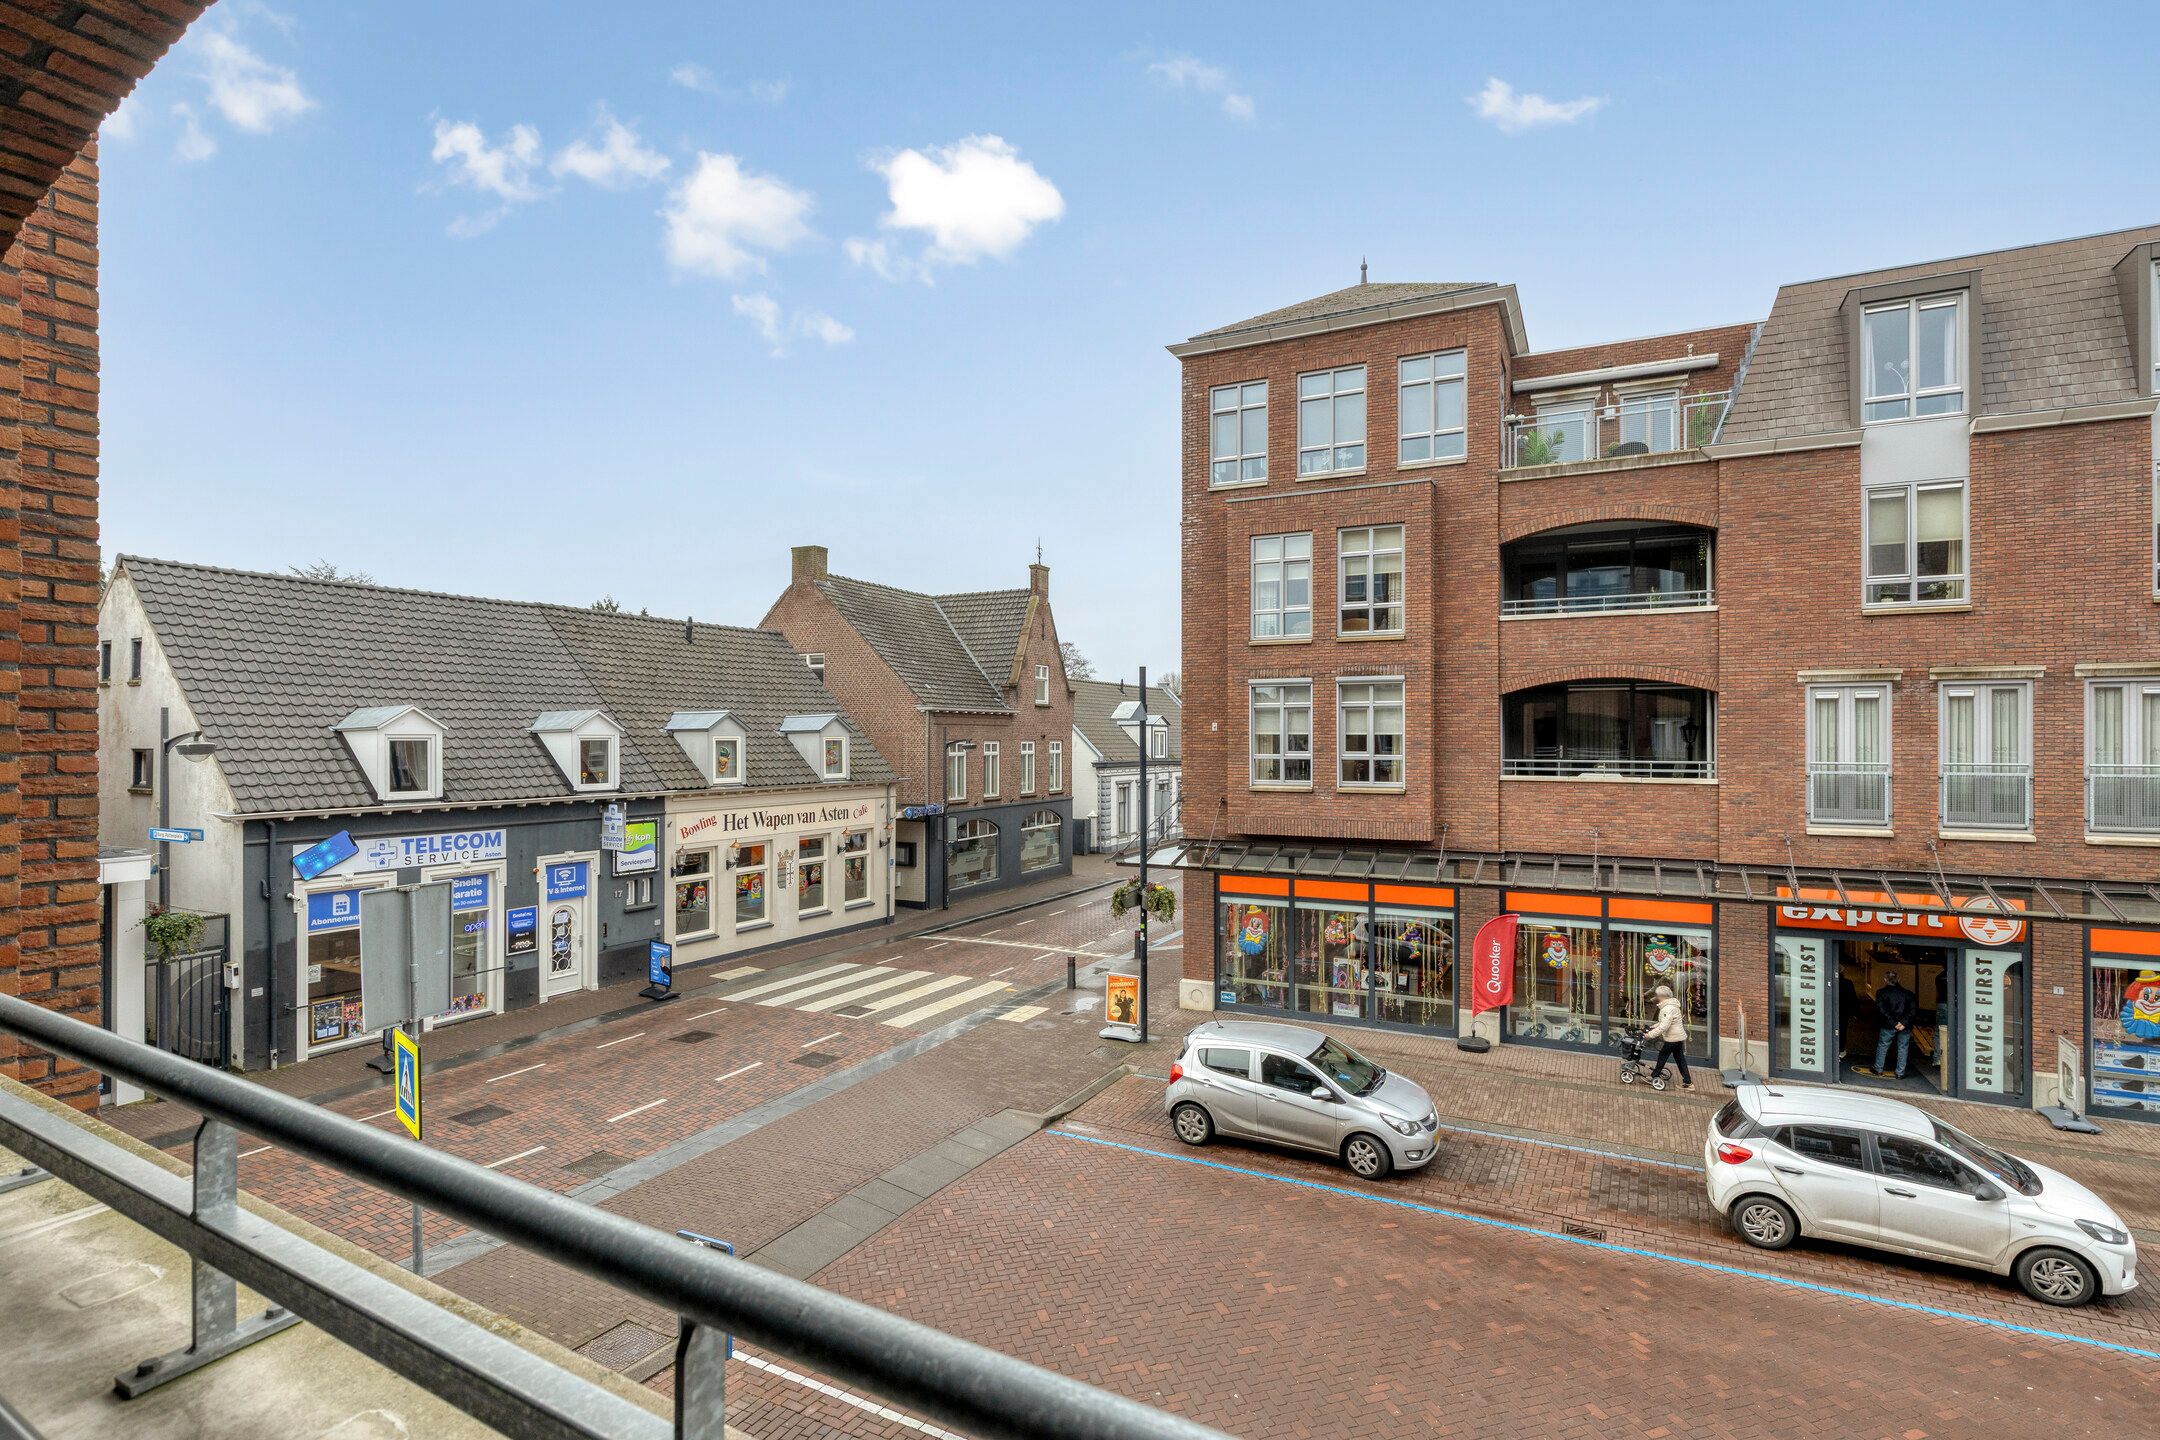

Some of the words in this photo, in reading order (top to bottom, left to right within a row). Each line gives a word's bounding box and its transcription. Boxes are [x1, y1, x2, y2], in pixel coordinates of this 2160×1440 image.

[680, 815, 718, 839] Bowling
[722, 813, 749, 832] Het
[752, 810, 794, 831] Wapen
[796, 811, 816, 824] van
[818, 806, 849, 822] Asten
[400, 831, 502, 855] TELECOM
[635, 833, 651, 842] kpn
[404, 849, 479, 865] SERVICE
[620, 857, 652, 867] Servicepunt
[453, 877, 483, 888] Snelle
[560, 884, 586, 893] Internet
[453, 887, 483, 899] aratie
[614, 889, 623, 897] 17
[464, 920, 486, 933] open
[1486, 939, 1502, 994] Quooker
[1800, 944, 1816, 989] FIRST
[1975, 957, 1993, 1006] FIRST
[1800, 998, 1816, 1065] SERVICE
[1975, 1013, 1993, 1086] SERVICE
